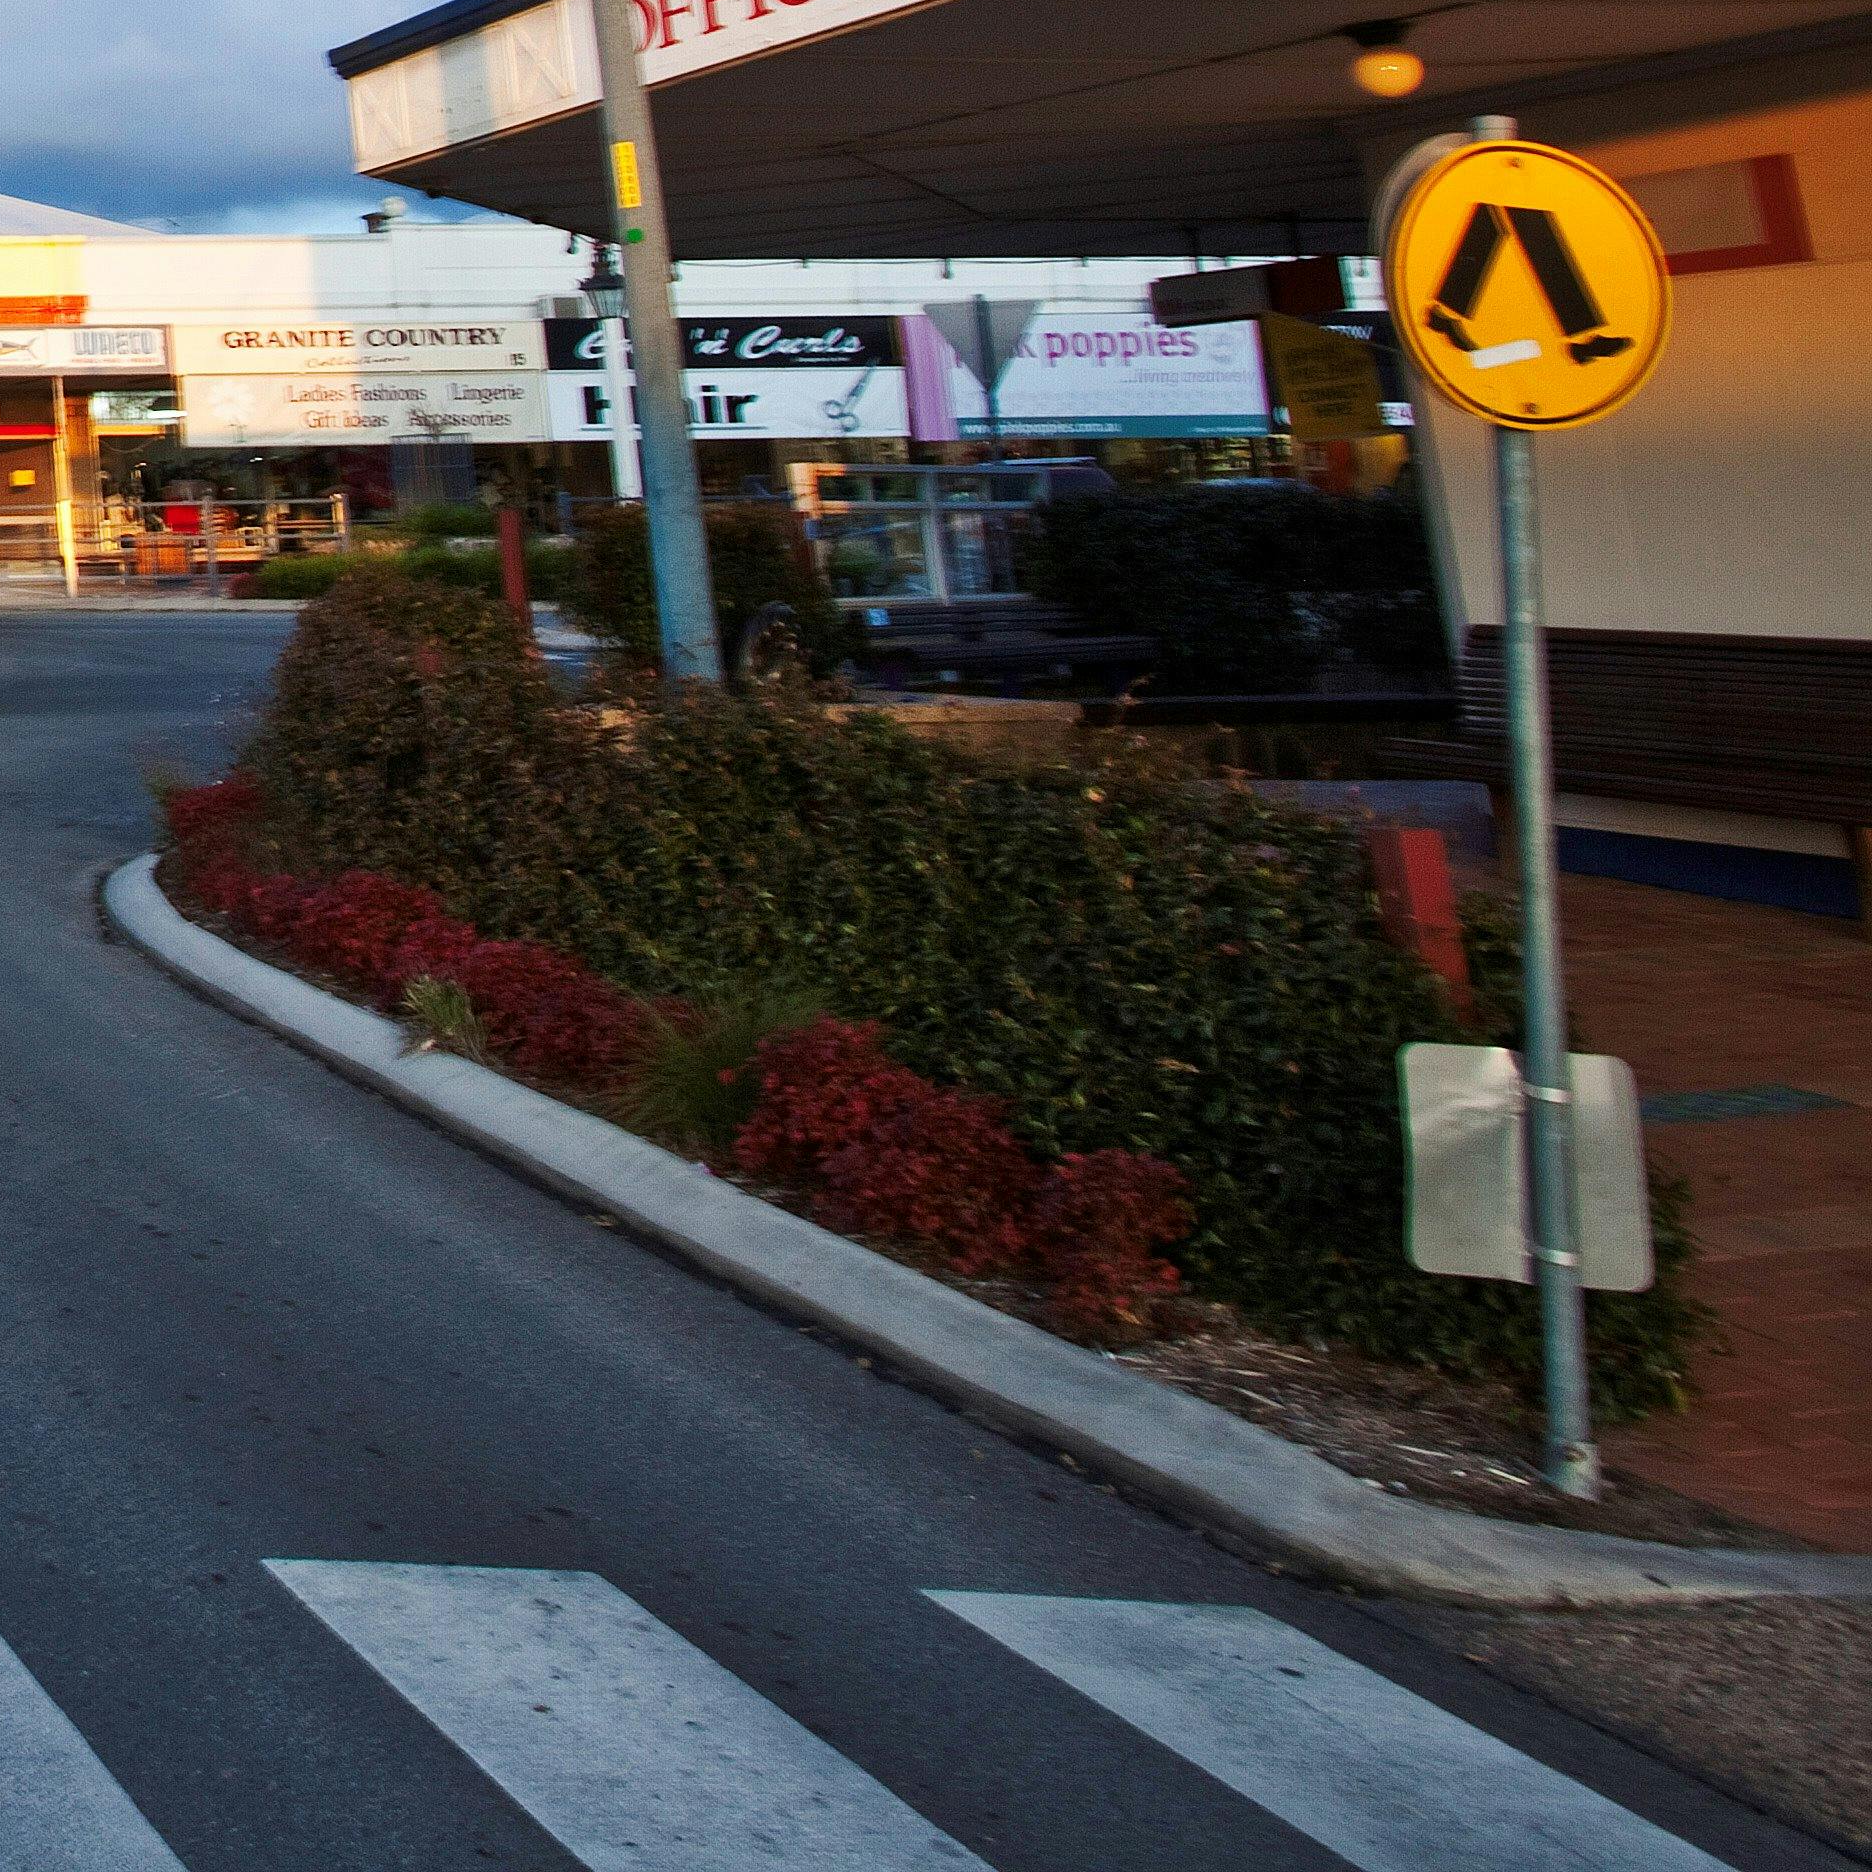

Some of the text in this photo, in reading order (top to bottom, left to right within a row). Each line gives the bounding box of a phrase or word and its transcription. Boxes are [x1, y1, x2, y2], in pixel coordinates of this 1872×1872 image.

[223, 328, 506, 349] GRANITE COUNTRY
[735, 325, 867, 359] Curls
[1039, 321, 1200, 368] poppies
[284, 382, 525, 405] Ladies Fashions Lingerie
